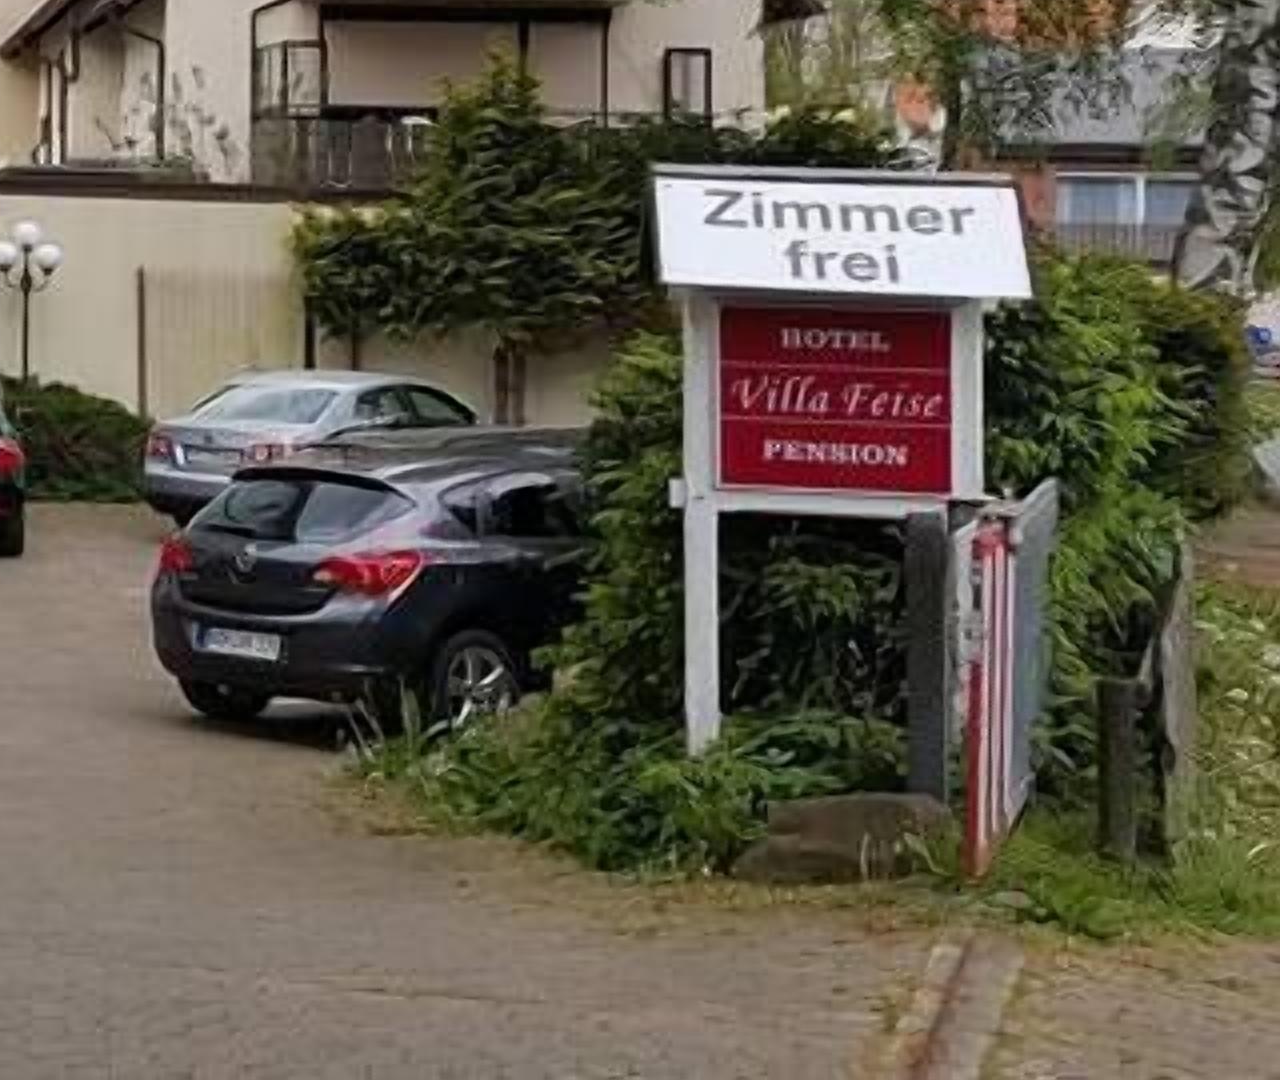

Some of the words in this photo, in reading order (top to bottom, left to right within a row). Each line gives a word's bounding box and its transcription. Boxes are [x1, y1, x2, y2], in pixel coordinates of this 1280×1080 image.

[702, 188, 976, 235] Zimmer
[784, 240, 901, 284] frei
[781, 327, 891, 351] HOTEL
[732, 375, 829, 413] Villa
[762, 438, 910, 465] PENSION
